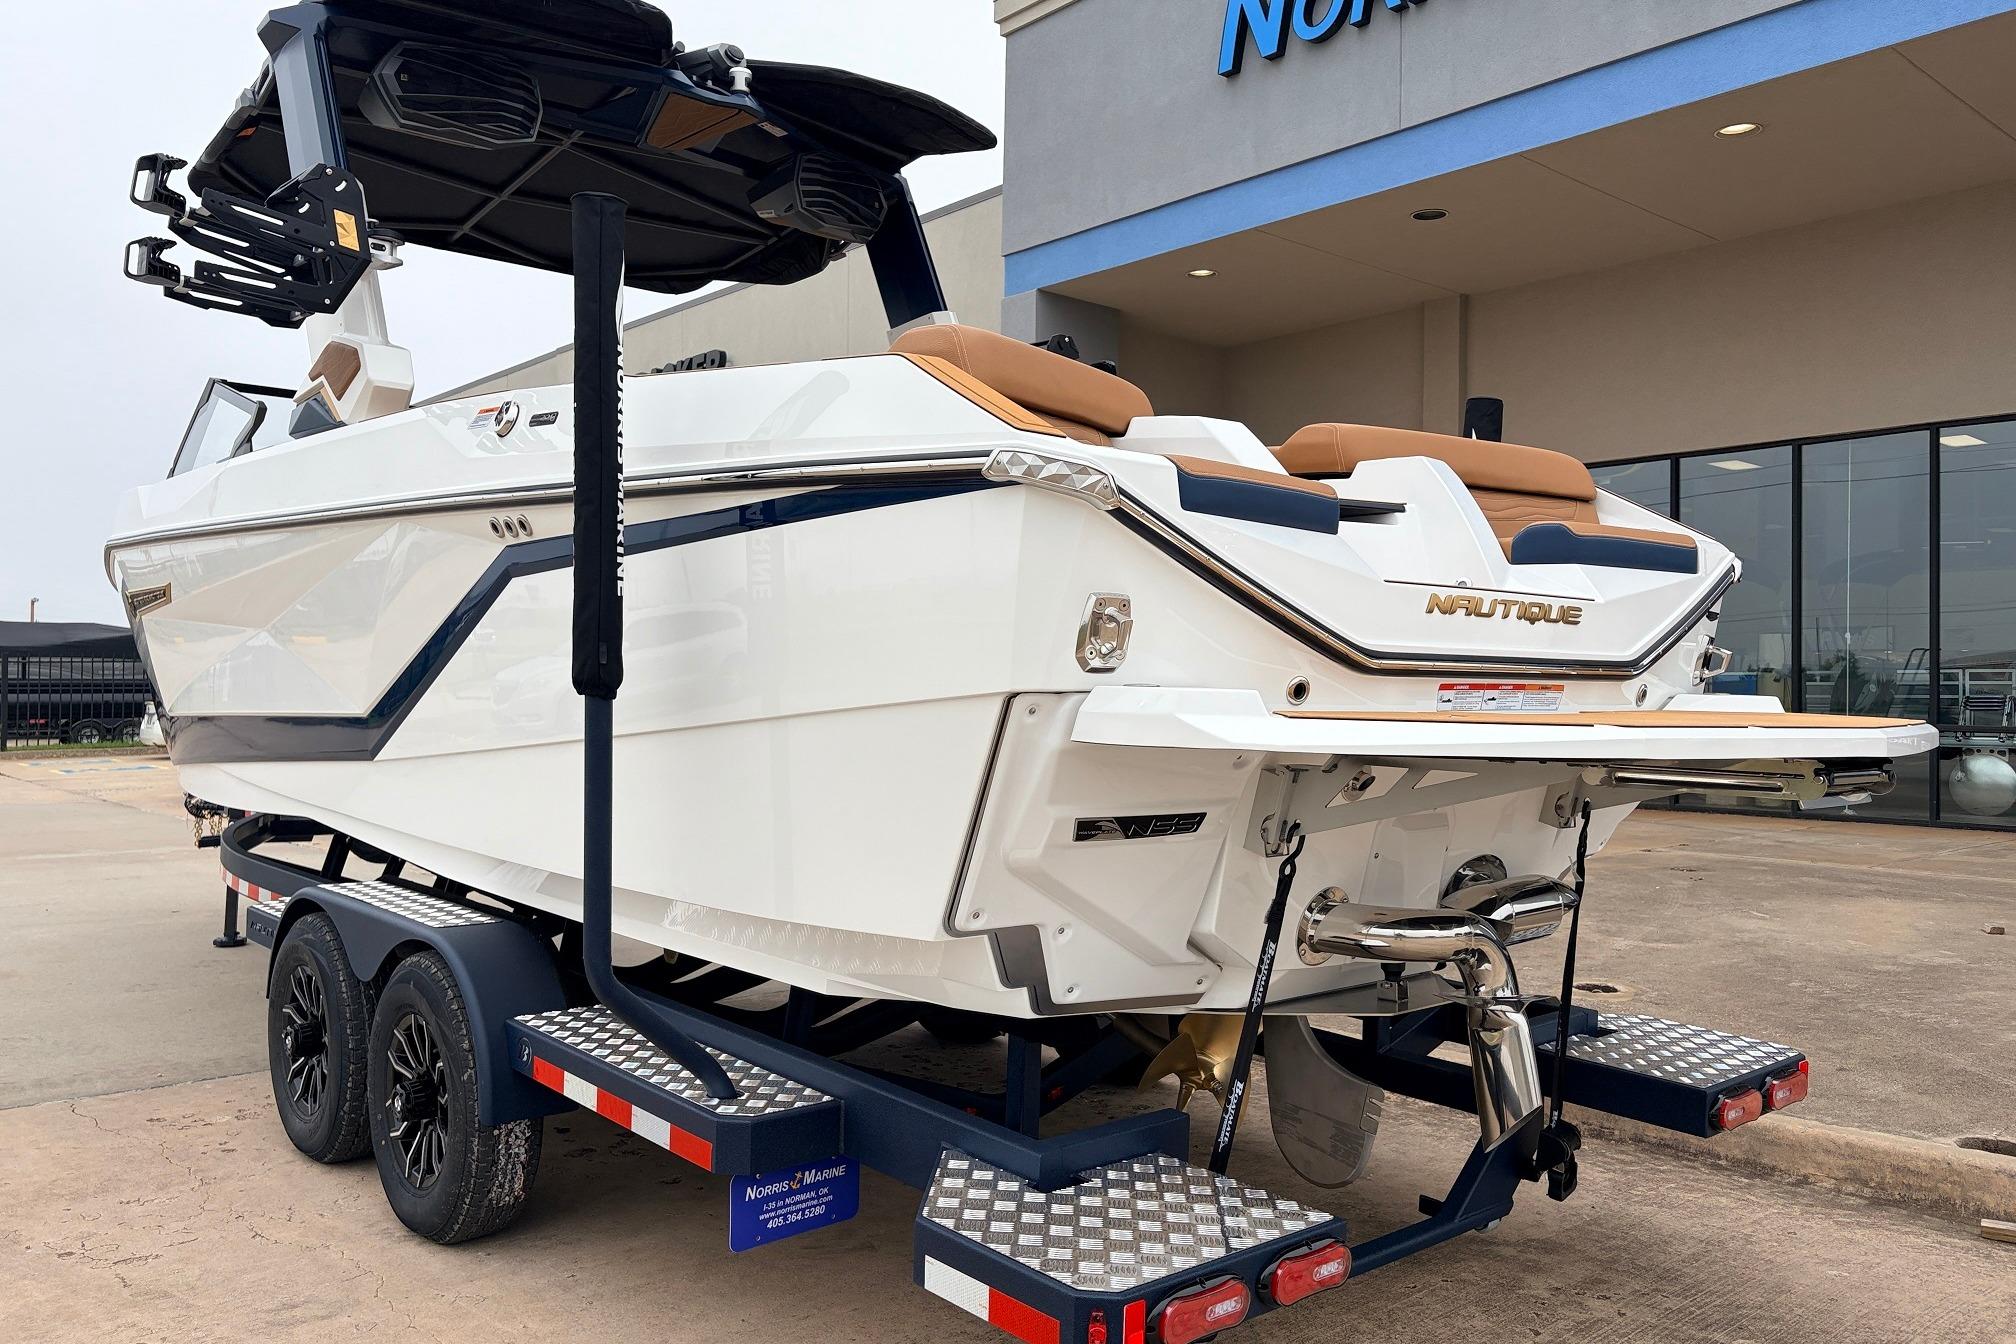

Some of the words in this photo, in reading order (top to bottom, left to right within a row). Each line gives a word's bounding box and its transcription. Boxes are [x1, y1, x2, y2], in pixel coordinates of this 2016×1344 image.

[1425, 593, 1583, 625] NAUTIQUE
[745, 1180, 789, 1202] NORRIS
[803, 1164, 847, 1186] MARINE
[784, 1191, 817, 1205] NORMAN,
[818, 1186, 830, 1197] OK
[759, 1195, 833, 1220] www.norrismarine.com
[766, 1204, 826, 1229] 405.364.5280
